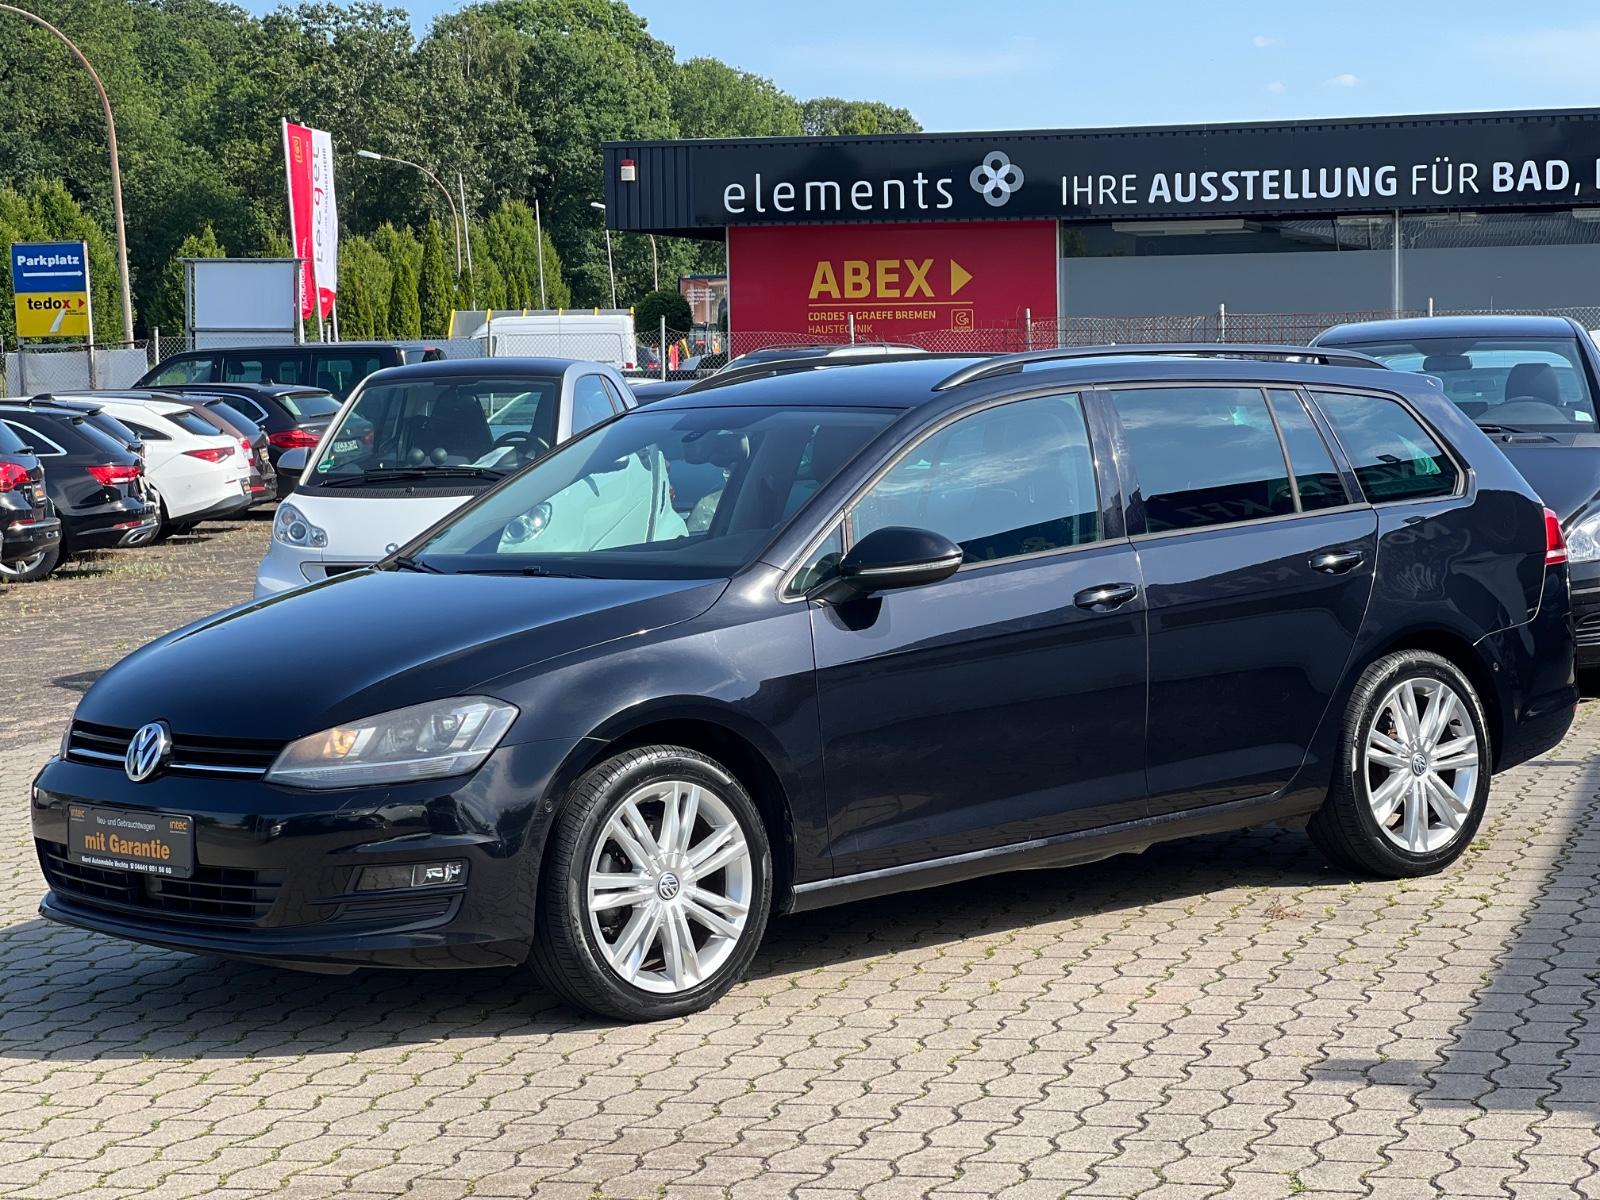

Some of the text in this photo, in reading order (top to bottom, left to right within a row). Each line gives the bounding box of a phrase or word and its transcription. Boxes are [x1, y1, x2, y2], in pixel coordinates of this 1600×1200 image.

[1062, 174, 1137, 206] IHRE
[1147, 165, 1397, 204] AUSSTELLUNG
[1411, 157, 1480, 195] FÜR
[1492, 159, 1581, 197] BAD,
[723, 172, 954, 214] elements
[17, 254, 80, 267] Parkplatz
[808, 258, 935, 299] ABEX
[27, 297, 71, 310] tedox
[808, 312, 845, 320] CORDES
[856, 311, 893, 320] GRAEFE
[895, 310, 936, 319] BREMEN
[169, 820, 188, 831] intec
[84, 832, 170, 860] mit Garantie
